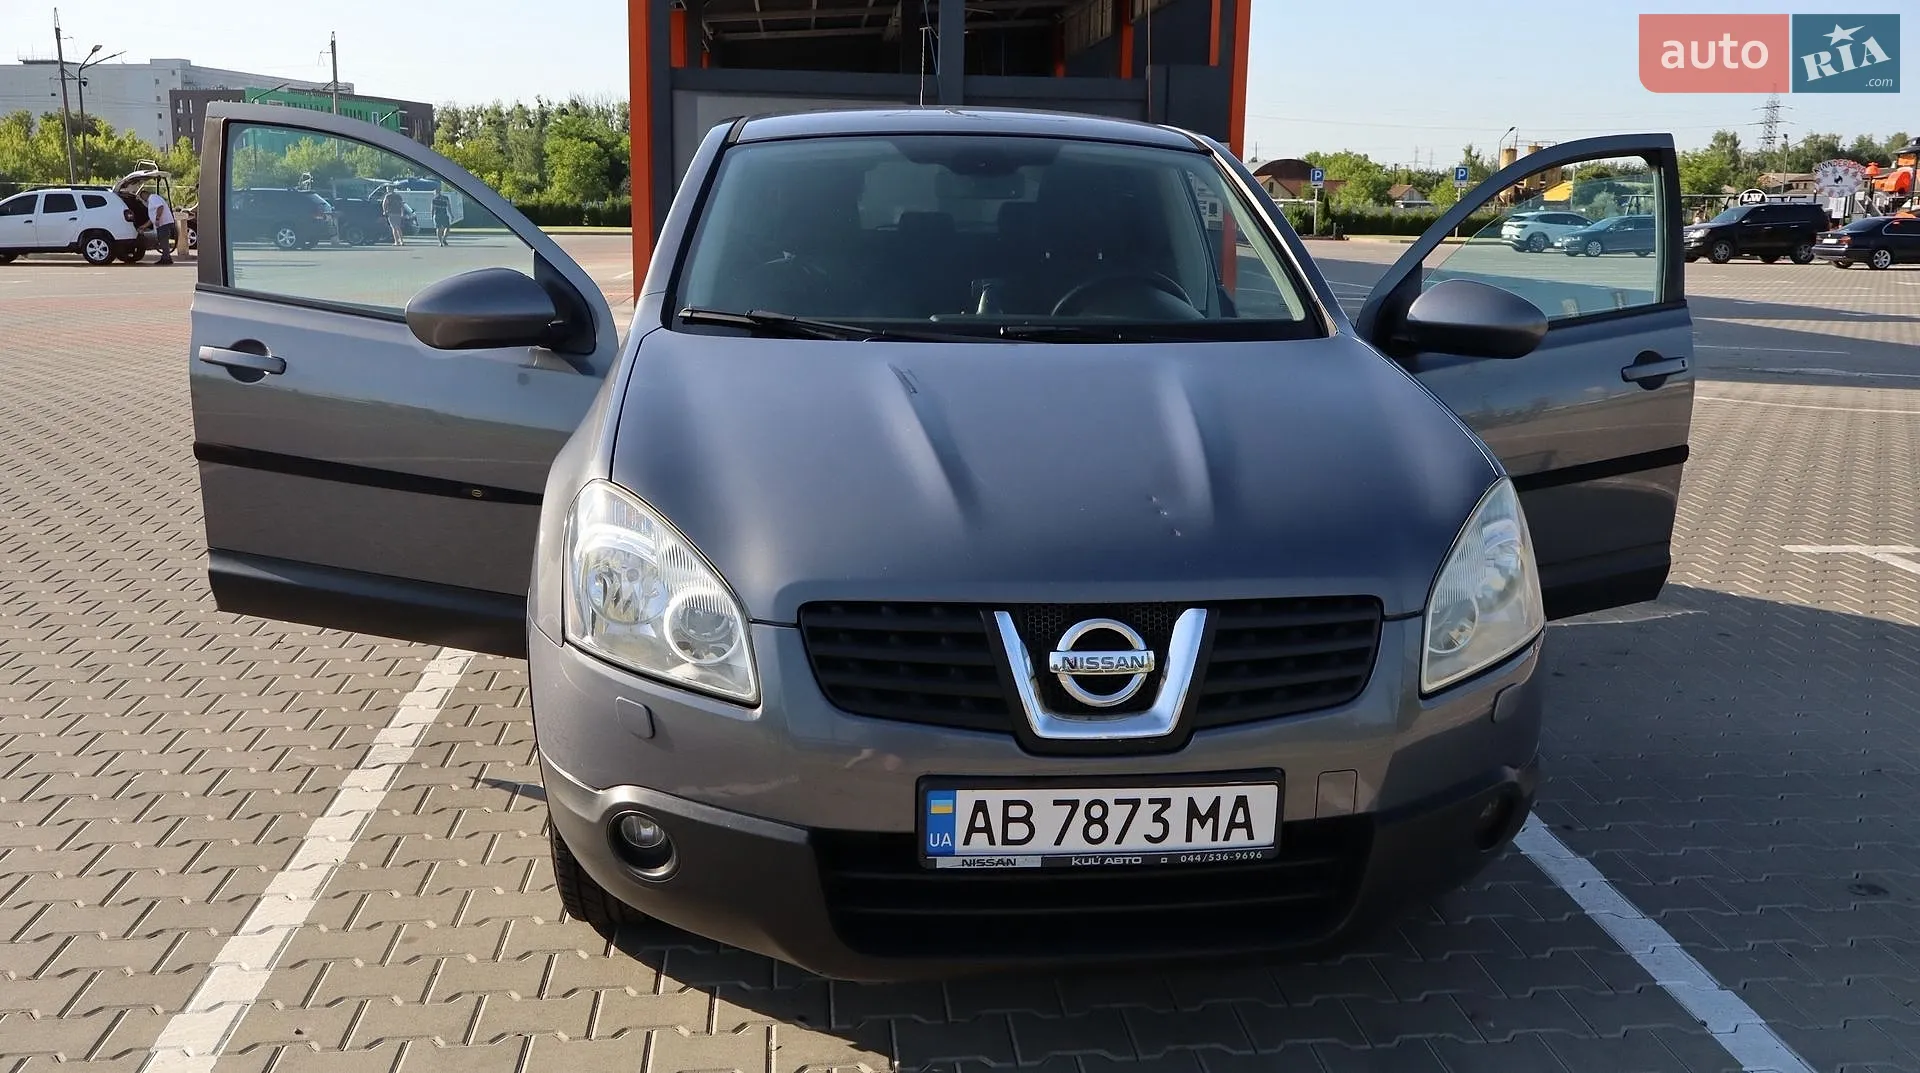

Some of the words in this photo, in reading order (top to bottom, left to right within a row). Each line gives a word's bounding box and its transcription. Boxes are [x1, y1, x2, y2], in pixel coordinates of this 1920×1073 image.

[1314, 170, 1322, 181] P
[1458, 168, 1466, 180] P
[1742, 193, 1763, 202] LW
[1061, 655, 1145, 671] NISSAN
[962, 799, 1036, 847] AB
[1052, 797, 1172, 846] 7873
[1185, 795, 1255, 843] MA
[929, 835, 952, 847] UA
[961, 857, 1017, 867] NISSAN
[1180, 851, 1263, 863] 044/536-9696
